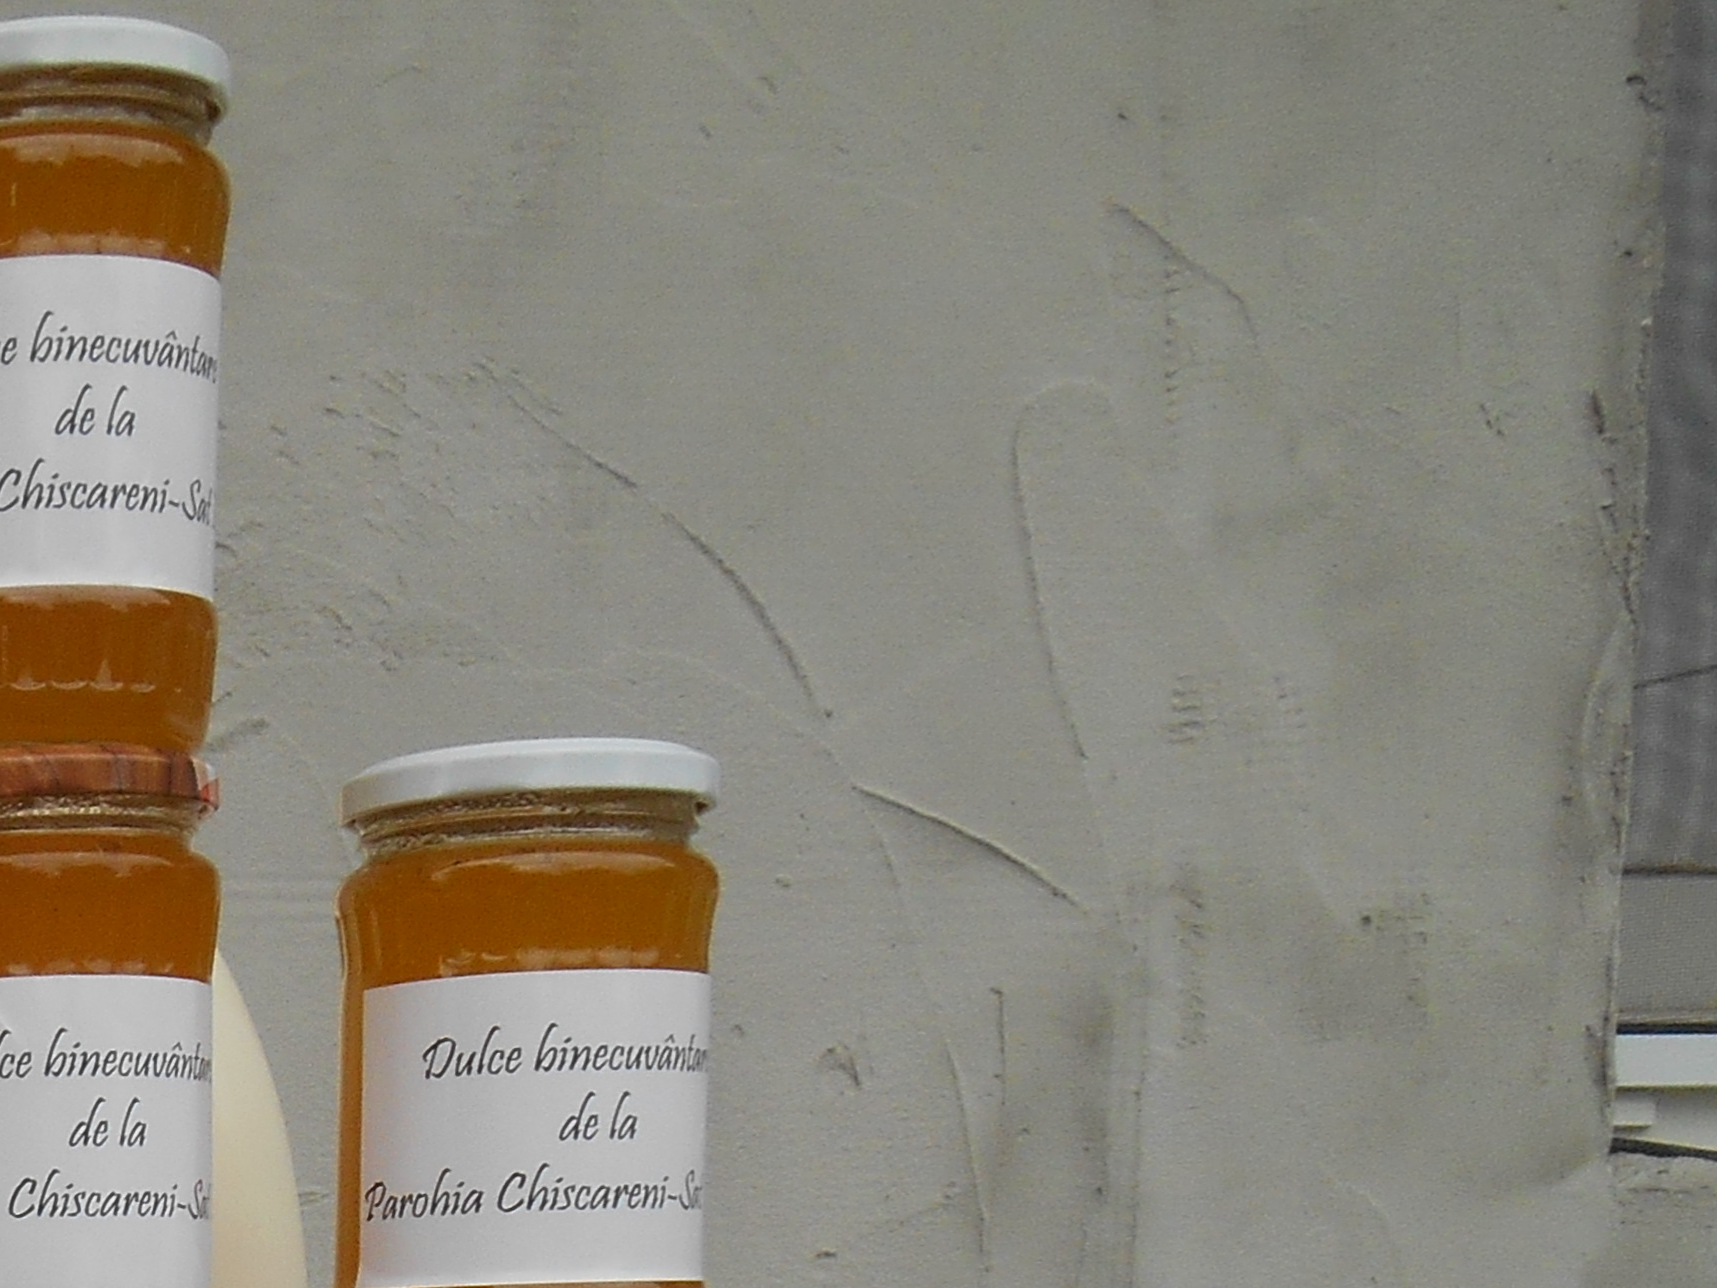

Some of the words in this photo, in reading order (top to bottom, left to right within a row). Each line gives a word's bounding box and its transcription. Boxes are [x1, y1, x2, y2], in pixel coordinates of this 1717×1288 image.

[54, 383, 94, 436] de
[106, 385, 136, 437] la
[423, 1026, 522, 1080] Dulce
[69, 1097, 108, 1147] de
[119, 1097, 147, 1147] la
[559, 1092, 598, 1142] de
[610, 1091, 637, 1140] la
[365, 1169, 482, 1221] Parohia
